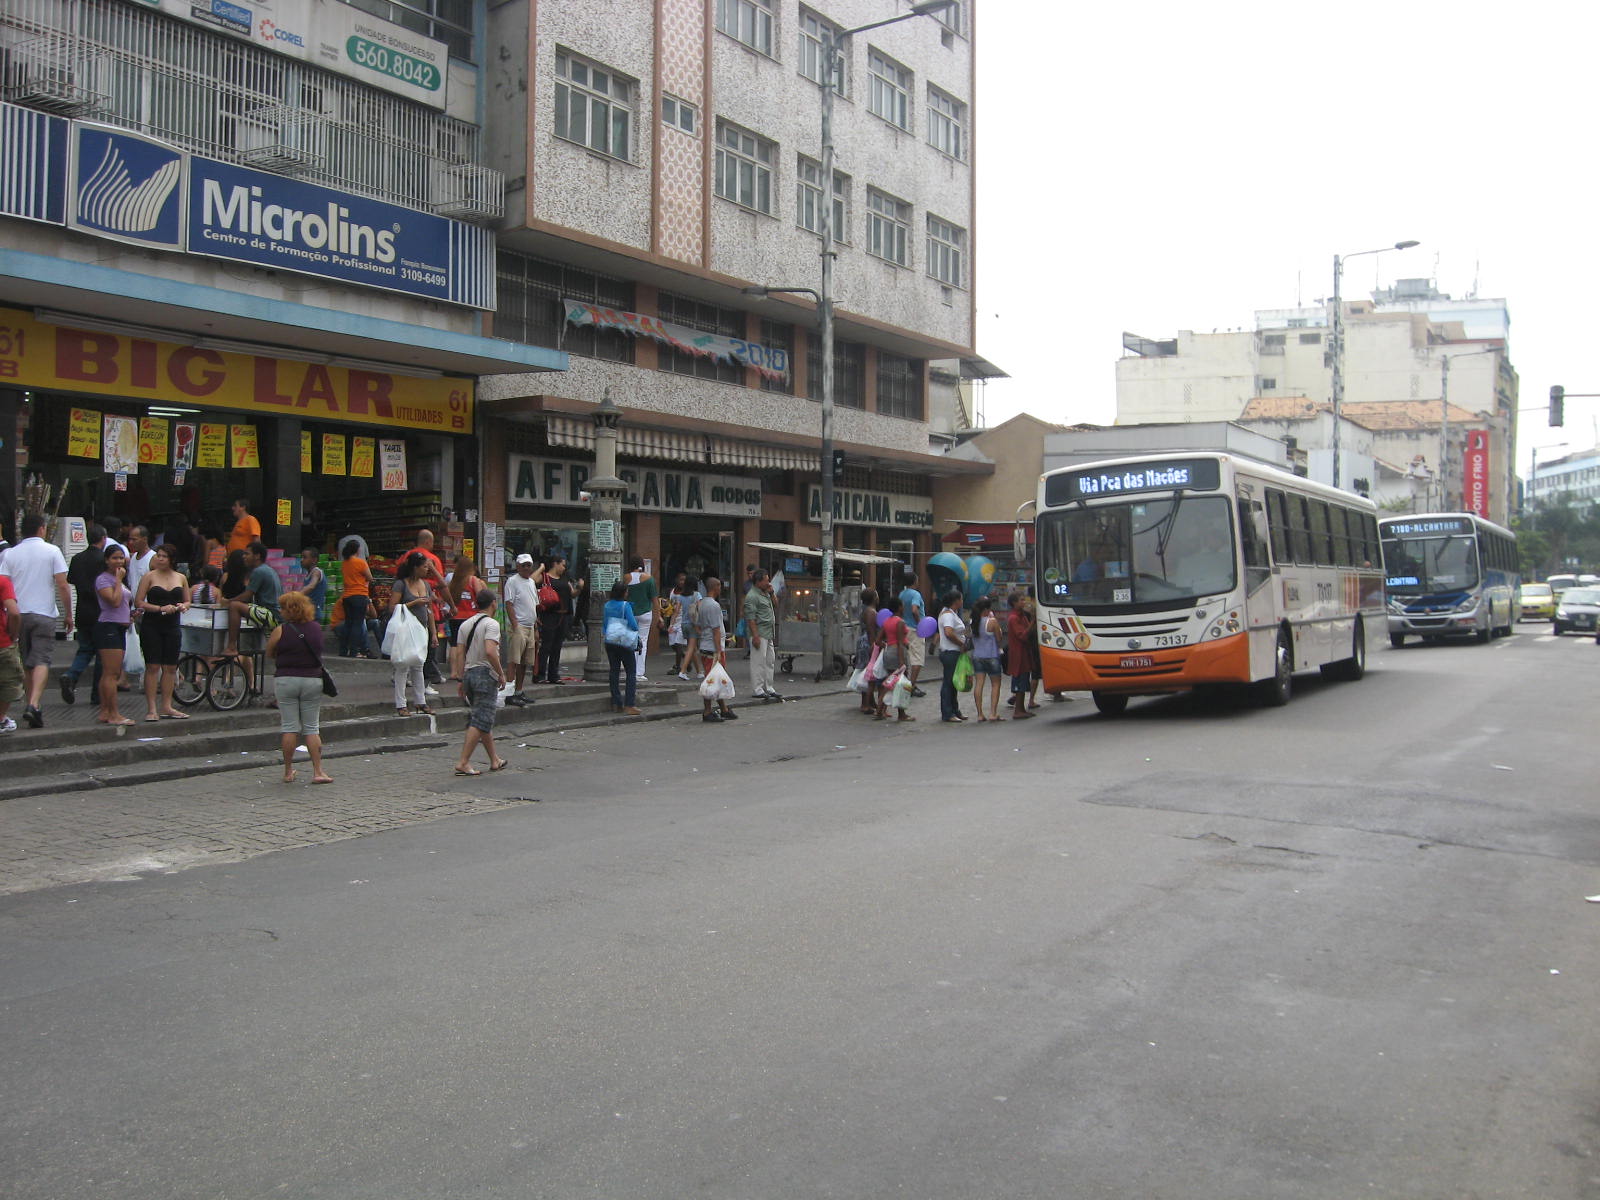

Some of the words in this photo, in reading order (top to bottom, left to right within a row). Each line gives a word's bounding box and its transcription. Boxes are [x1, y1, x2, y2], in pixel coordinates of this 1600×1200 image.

[213, 1, 250, 24] Certified
[222, 19, 249, 33] Provider
[274, 28, 304, 47] COREL
[354, 24, 387, 43] UNIDADE
[355, 40, 433, 87] 560.8042
[203, 178, 396, 263] Microlins
[203, 229, 247, 246] Centro
[250, 238, 266, 250] de
[270, 241, 329, 263] Formação
[332, 254, 396, 276] Profissional
[401, 267, 446, 287] 3109-6499
[729, 339, 786, 371] 2010
[55, 326, 227, 397] BIG
[253, 355, 394, 418] LAR
[448, 389, 468, 413] 61
[396, 406, 444, 424] UTILIDADES
[452, 415, 465, 428] B
[1473, 454, 1483, 480] FRIO
[515, 460, 704, 510] AFRCANA
[1079, 477, 1098, 494] Via
[1123, 472, 1144, 488] das
[810, 488, 891, 523] ARICANA
[1054, 584, 1068, 595] 02
[1154, 634, 1188, 646] 73137
